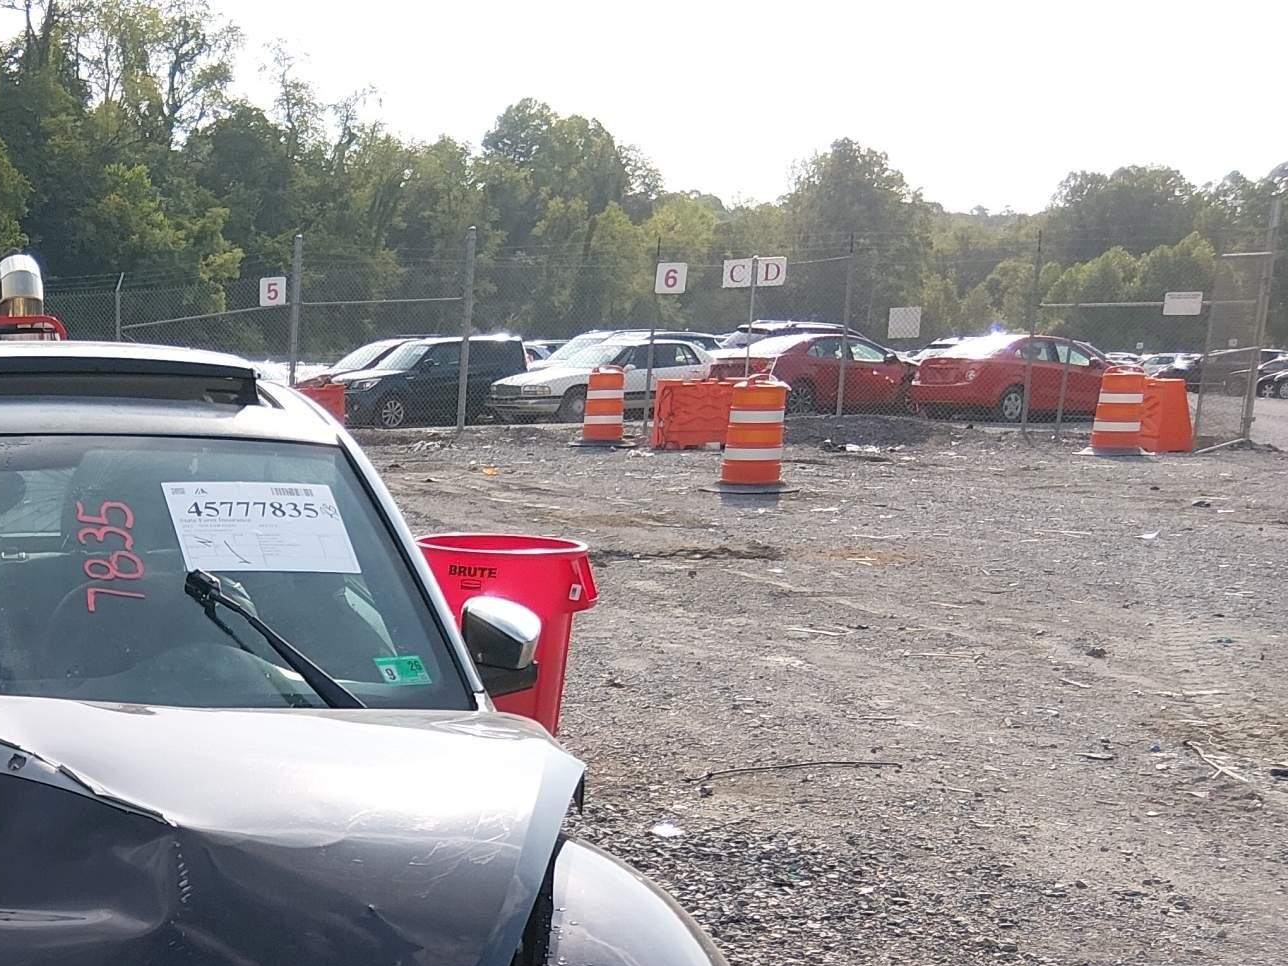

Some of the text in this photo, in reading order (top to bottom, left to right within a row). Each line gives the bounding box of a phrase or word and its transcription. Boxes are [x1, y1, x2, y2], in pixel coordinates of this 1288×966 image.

[664, 269, 678, 288] 6
[729, 263, 781, 283] C D
[267, 283, 279, 300] 5
[187, 501, 319, 519] 45777835
[76, 501, 146, 613] 7835
[449, 564, 497, 579] BRUTE
[385, 668, 396, 680] 9
